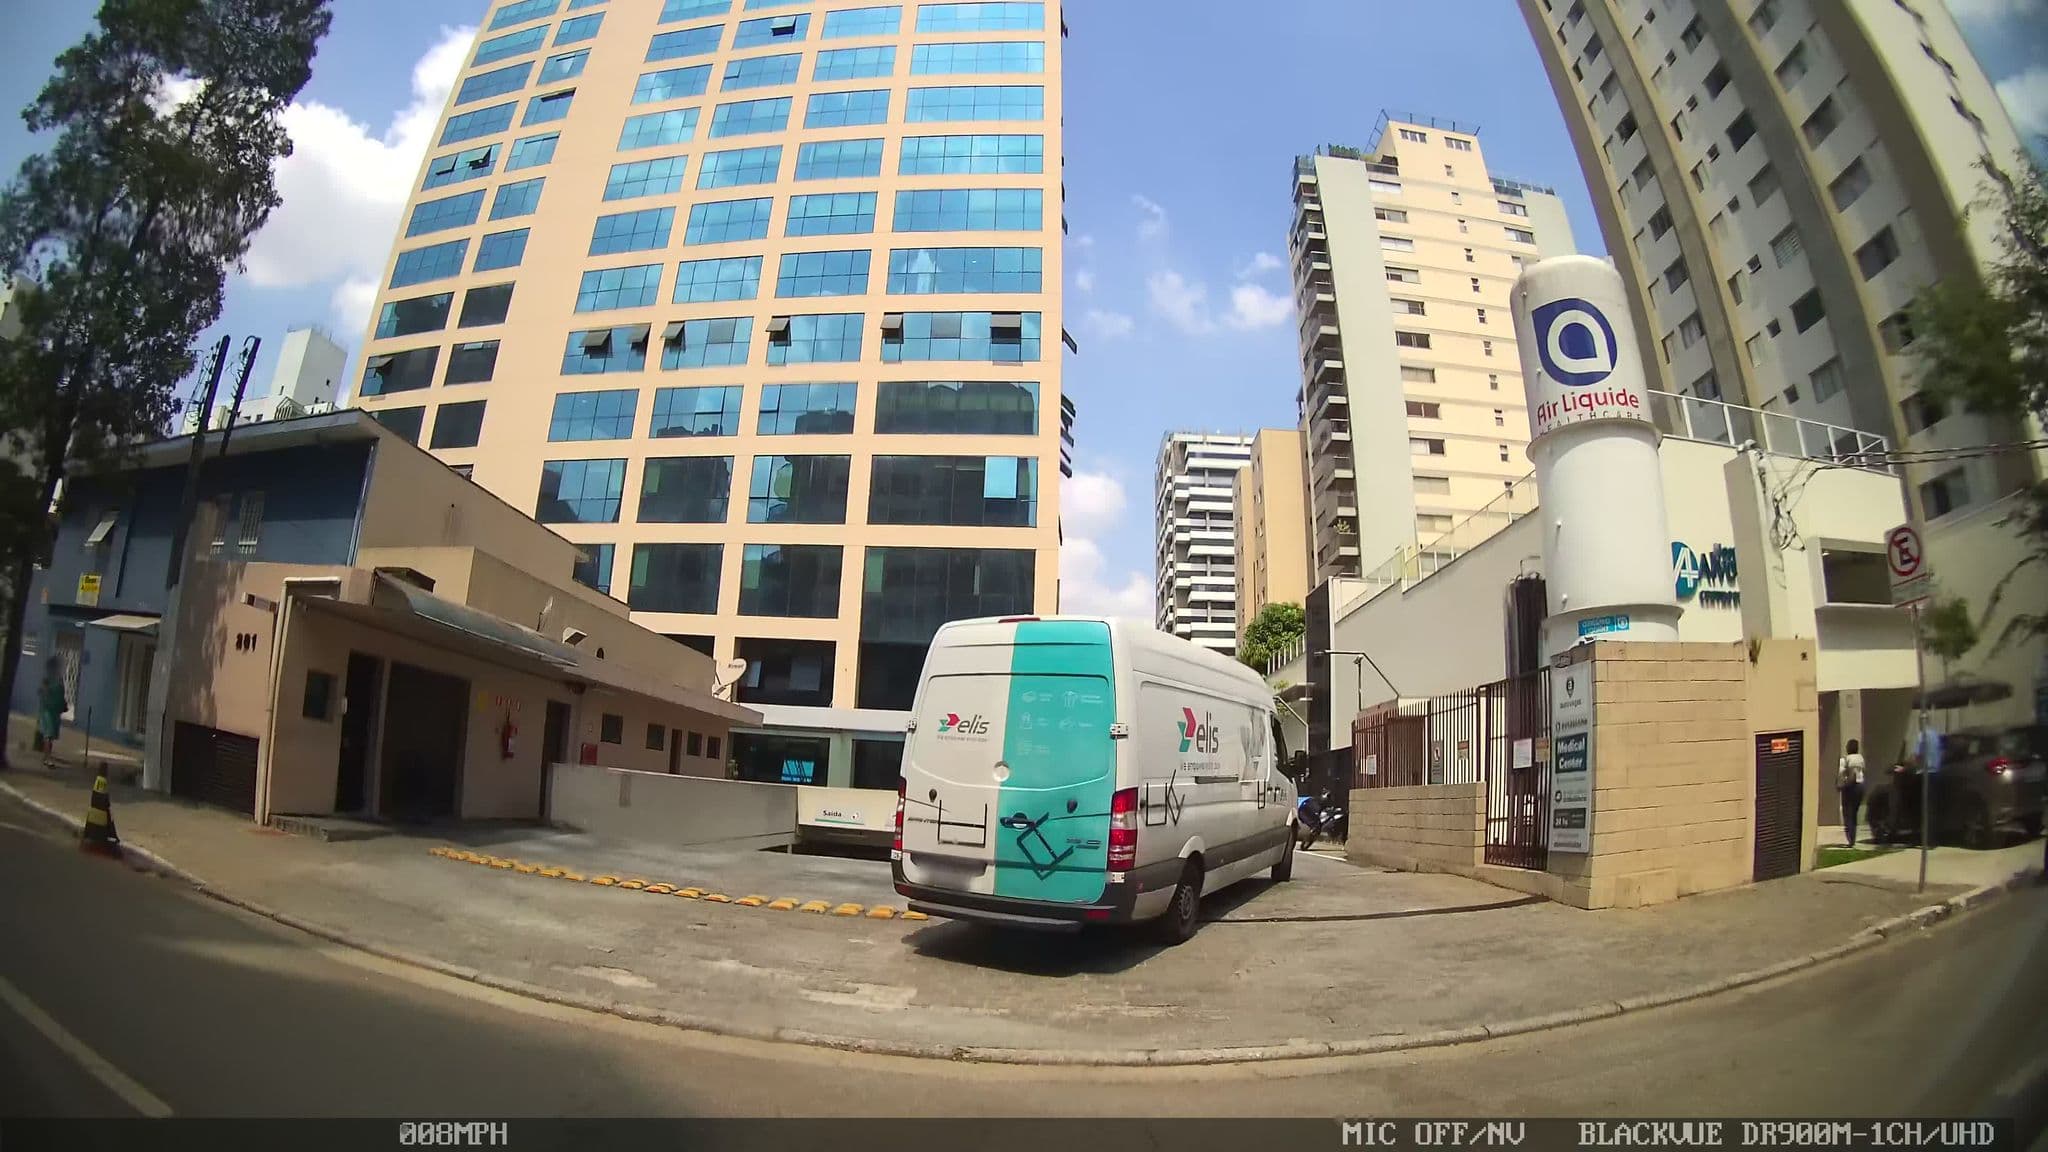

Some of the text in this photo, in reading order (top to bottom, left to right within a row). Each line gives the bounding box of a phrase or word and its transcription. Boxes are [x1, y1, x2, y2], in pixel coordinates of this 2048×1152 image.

[1537, 387, 1640, 425] Air Liquide
[957, 714, 990, 734] elis
[1196, 710, 1219, 753] elis
[1557, 736, 1585, 753] Medical
[1559, 757, 1584, 769] Center
